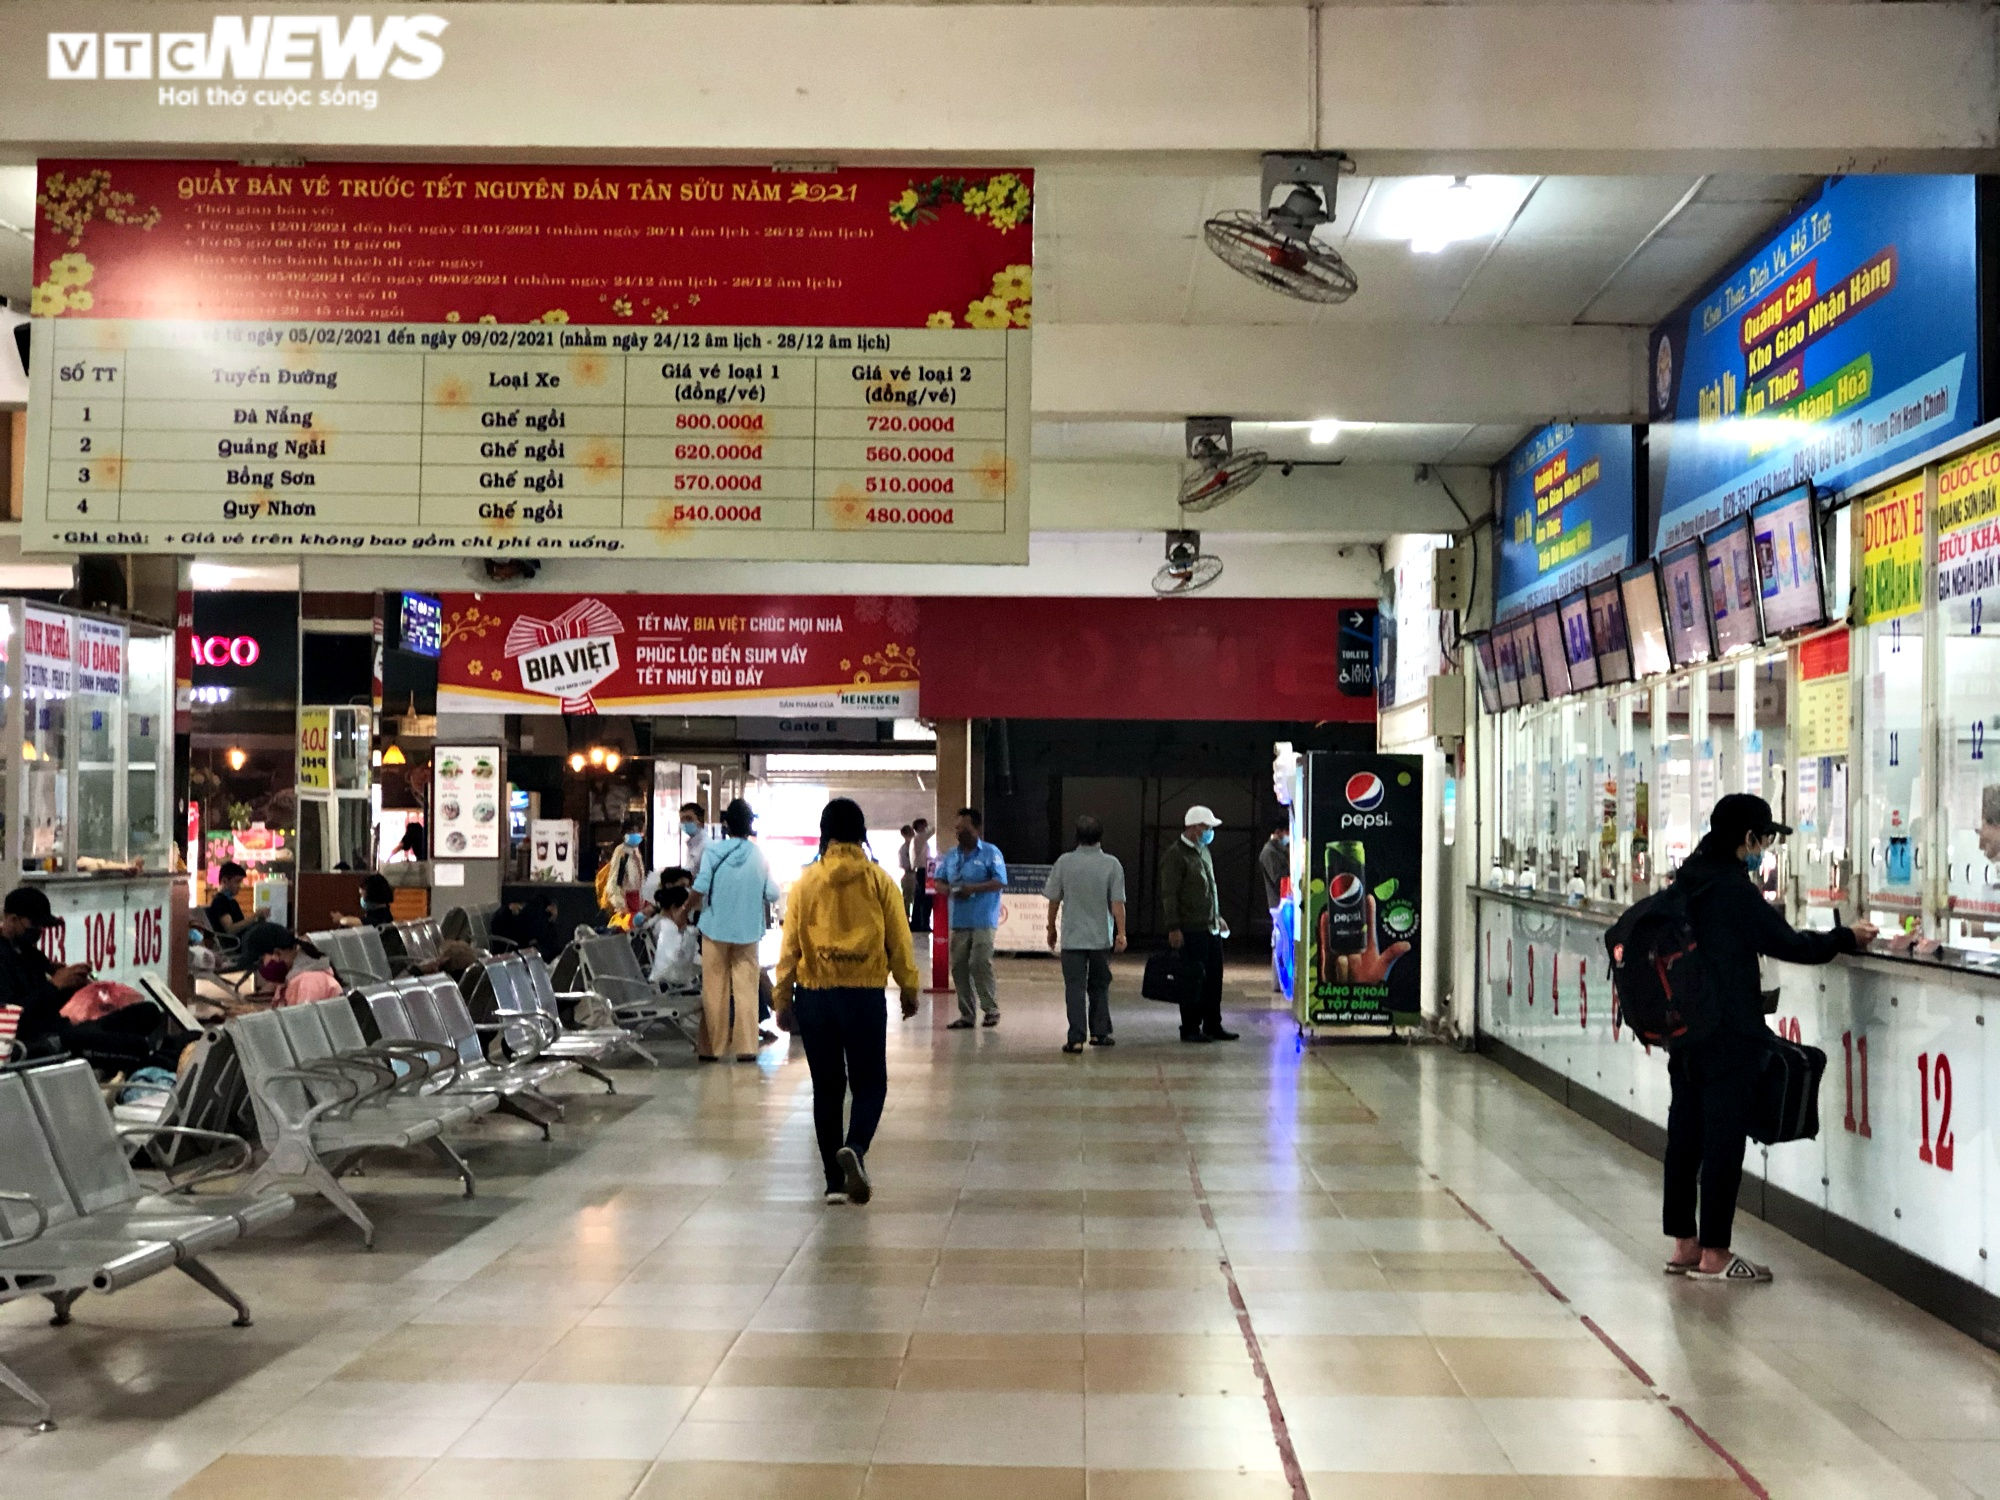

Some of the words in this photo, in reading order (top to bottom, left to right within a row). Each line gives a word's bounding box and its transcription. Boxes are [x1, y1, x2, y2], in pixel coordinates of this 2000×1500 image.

[246, 173, 292, 196] BÁN
[302, 174, 331, 197] VÉ
[339, 175, 415, 199] TRƯỚC
[422, 173, 467, 199] TẾT
[475, 177, 565, 200] NGUYÊN
[573, 177, 619, 201] ĐÁN
[627, 178, 672, 201] TÂN
[680, 176, 724, 201] SỬU
[732, 179, 781, 201] NĂM
[787, 179, 858, 204] 2021
[1744, 297, 1783, 344] Quảng
[1786, 274, 1812, 313] Cáo
[1748, 343, 1773, 378] Kho
[1775, 319, 1805, 359] Giao
[1808, 288, 1846, 336] Nhận
[1850, 257, 1891, 307] Hàng
[288, 328, 381, 346] 05/02/2021
[387, 327, 416, 346] đến
[421, 330, 456, 349] ngày
[462, 330, 553, 347] 09/02/2021
[559, 328, 607, 348] (nhằm
[612, 332, 648, 351] ngày
[653, 332, 700, 349] 24/12
[705, 332, 729, 349] âm
[733, 332, 761, 351] lịch
[777, 333, 824, 350] 28/12
[829, 333, 852, 350] âm
[857, 333, 891, 352] lịch)
[60, 361, 86, 382] SỐ
[92, 367, 118, 382] TT
[211, 364, 271, 387] Tuyến
[277, 367, 338, 389] Đường
[489, 371, 529, 391] Loại
[535, 372, 560, 388] Xe
[661, 364, 692, 380] Giá
[700, 364, 721, 380] vé
[728, 363, 762, 382] loại
[770, 365, 779, 380] 1
[851, 365, 883, 381] Giá
[890, 365, 911, 381] vé
[918, 365, 953, 384] loại
[960, 367, 972, 382] 2
[674, 381, 766, 405] (đồng/vé)
[865, 383, 957, 406] (đồng/vé)
[1745, 380, 1765, 419] Ẩm
[1768, 366, 1799, 405] Thực
[1798, 385, 1834, 423] Hàng
[1837, 366, 1868, 406] Hóa
[82, 408, 91, 422] 1
[233, 408, 257, 424] Đà
[481, 409, 519, 428] Ghế
[525, 410, 566, 432] ngồi
[675, 414, 764, 431] 800.000đ
[866, 415, 955, 432] 720.000đ
[79, 437, 91, 453] 2
[218, 437, 278, 458] Quảng
[285, 439, 326, 459] Ngãi
[480, 440, 519, 458] Ghế
[524, 440, 565, 462] ngồi
[674, 443, 763, 461] 620.000đ
[865, 446, 955, 463] 560.000đ
[78, 468, 90, 483] 3
[226, 465, 274, 489] Bồng
[280, 469, 315, 485] Sơn
[479, 471, 518, 489] Ghế
[523, 471, 564, 493] ngồi
[673, 474, 762, 491] 570.000đ
[865, 477, 955, 494] 510.000đ
[1940, 454, 1979, 495] QUỐC
[77, 498, 89, 514] 4
[223, 500, 260, 519] Quy
[267, 500, 316, 516] Nhơn
[478, 501, 518, 519] Ghế
[522, 502, 564, 523] ngồi
[673, 505, 762, 522] 540.000đ
[865, 507, 954, 524] 480.000đ
[1864, 490, 1910, 553] DUYÊN
[105, 530, 150, 545] chú:
[181, 531, 217, 545] Giá
[221, 532, 244, 545] vé
[250, 533, 293, 546] trên
[299, 533, 366, 550] không
[369, 534, 407, 547] bao
[411, 533, 456, 549] gồm
[461, 536, 493, 548] chi
[497, 536, 531, 551] phí
[537, 537, 563, 549] ăn
[568, 533, 625, 551] uống.
[1938, 532, 1967, 563] HỮU
[637, 611, 663, 632] TẾT
[664, 614, 691, 633] NÀY,
[694, 616, 715, 632] BIA
[718, 615, 747, 635] VIỆT
[750, 614, 785, 632] CHÚC
[789, 616, 813, 635] MỌI
[816, 615, 843, 632] NHÀ
[1971, 597, 1982, 636] 12
[1892, 618, 1901, 653] 11
[92, 635, 121, 675] ĐĂNG
[525, 653, 564, 683] BIA
[565, 640, 611, 674] VIỆT
[636, 643, 676, 664] PHÚC
[680, 644, 708, 666] LỘC
[711, 641, 741, 664] ĐẾN
[745, 648, 777, 664] SUM
[1341, 650, 1369, 660] TOILETS
[636, 663, 663, 686] TẾT
[666, 667, 698, 686] NHƯ
[699, 666, 709, 686] Ý
[711, 665, 732, 686] ĐỦ
[735, 664, 764, 686] ĐẦY
[841, 694, 900, 705] HEINEKEN
[1889, 731, 1899, 766] 11
[1971, 720, 1984, 760] 12
[1341, 811, 1389, 830] pepsi
[1333, 912, 1362, 924] pepsi
[83, 911, 117, 972] 104
[132, 903, 163, 967] 105
[1506, 937, 1513, 998] 2
[1528, 944, 1535, 1007] 3
[1318, 982, 1350, 997] SẢNG
[1353, 984, 1389, 997] KHOÁI
[1552, 952, 1560, 1017] 4
[1580, 956, 1588, 1030] 5
[1841, 1029, 1873, 1140] 11
[1917, 1051, 1955, 1172] 12
